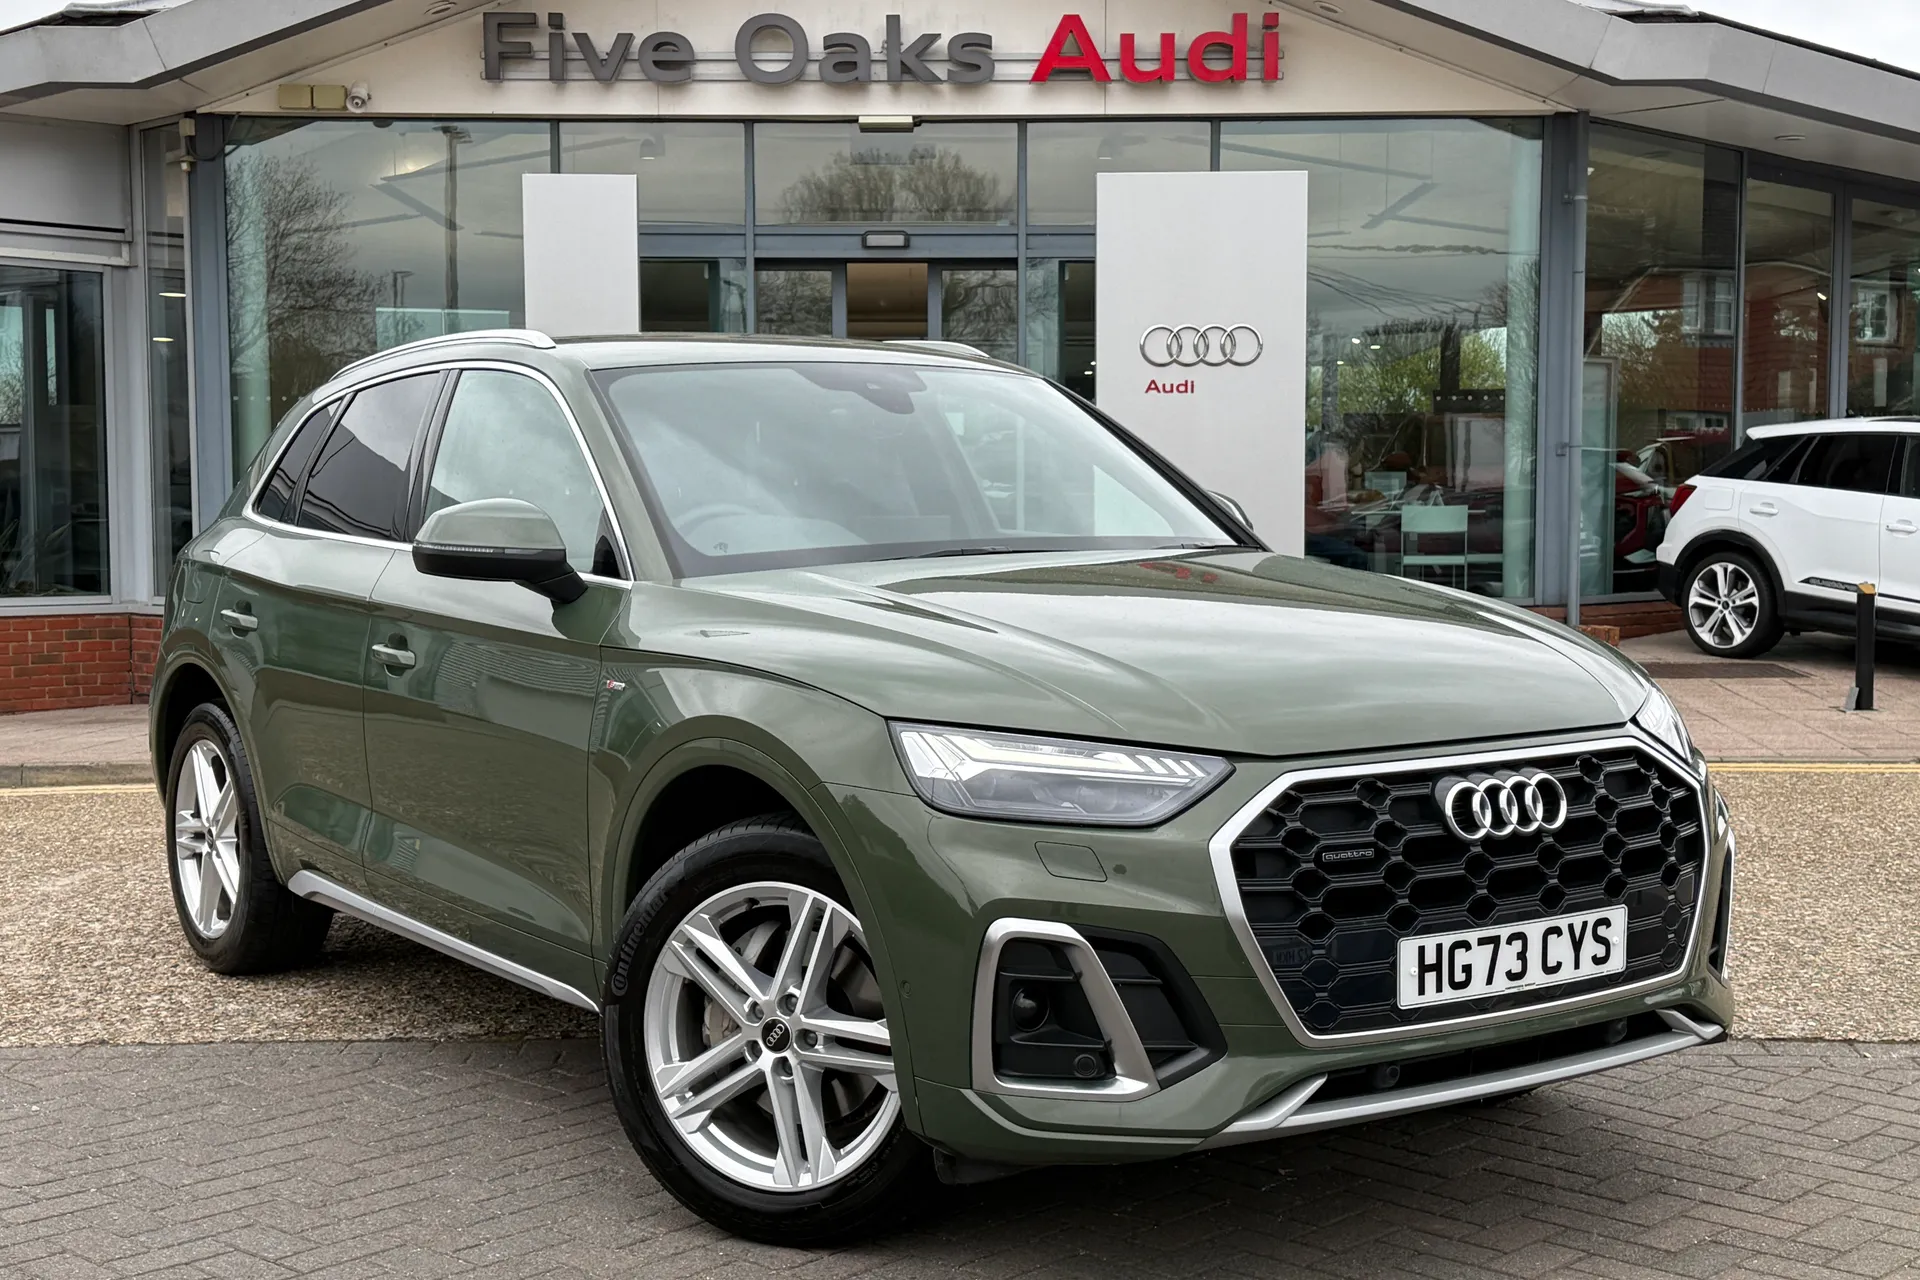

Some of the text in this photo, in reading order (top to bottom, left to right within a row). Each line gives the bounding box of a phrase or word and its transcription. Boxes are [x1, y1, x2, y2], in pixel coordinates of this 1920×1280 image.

[482, 12, 1280, 85] Five Oaks Audi
[1145, 379, 1195, 394] Audi
[1325, 850, 1373, 860] quattro
[1417, 917, 1613, 997] HG73 CYS
